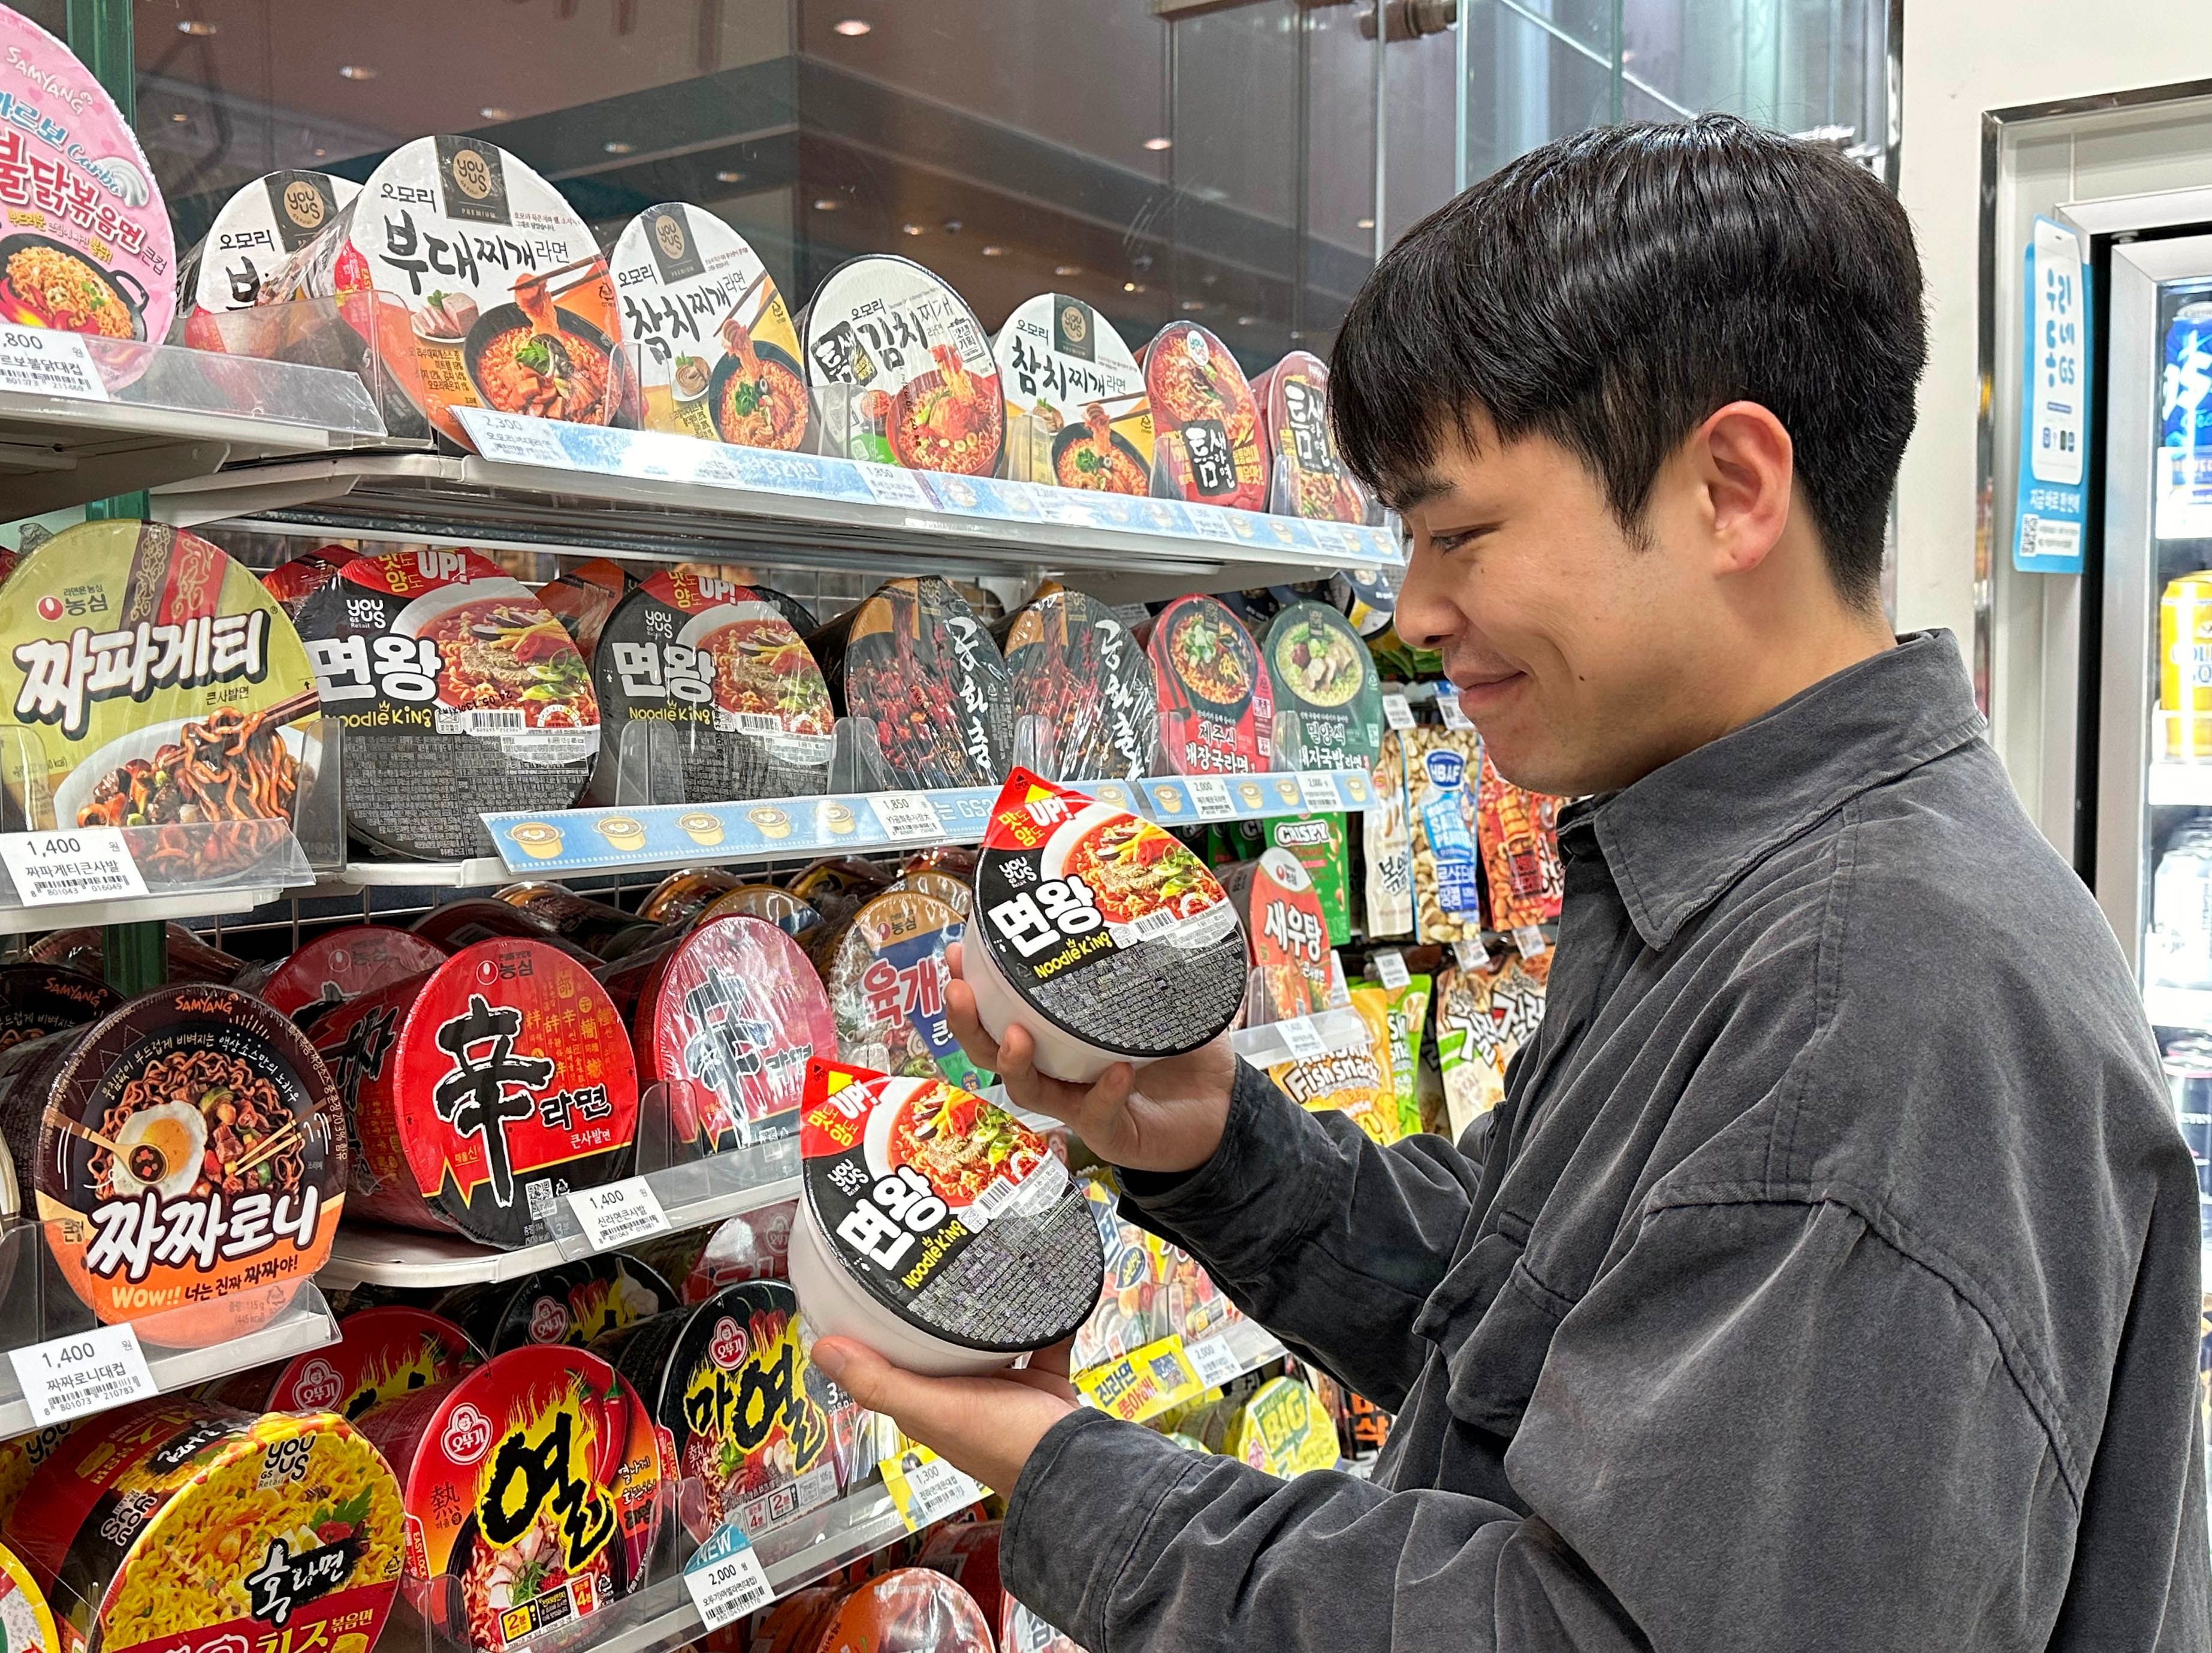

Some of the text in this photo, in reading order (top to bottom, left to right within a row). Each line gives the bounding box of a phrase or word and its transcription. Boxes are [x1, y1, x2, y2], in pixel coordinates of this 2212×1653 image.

[7, 47, 84, 115] SAMYANG
[67, 144, 122, 197] Carbo
[381, 182, 436, 213] 오모리
[461, 208, 496, 219] PREMIUM
[220, 230, 275, 251] 오모리
[141, 246, 168, 276] 큰컵
[618, 263, 659, 288] 오모리
[851, 298, 887, 321] 오모리
[1016, 318, 1049, 346] 오모리
[482, 415, 523, 431] 2,300
[417, 550, 469, 583] UP!
[698, 576, 737, 605] UP!
[65, 594, 108, 617] 농심
[14, 608, 266, 732] 짜파게티
[304, 635, 442, 702] 면왕
[611, 641, 717, 704] 면왕
[206, 686, 249, 705] 큰사발면
[1198, 720, 1237, 751] 제주식
[1306, 721, 1346, 746] 밀양식
[883, 798, 910, 811] 1,850
[955, 797, 999, 819] GS2
[1024, 795, 1075, 826] UP!
[1276, 822, 1329, 843] CRISPY
[27, 838, 120, 858] 1,400 원
[25, 861, 121, 879] 짜파게티큰사발
[31, 883, 123, 898] 8 801043 016049
[988, 876, 1103, 958] 면왕
[1264, 900, 1323, 963] 새우탕
[499, 959, 534, 980] 농심
[43, 977, 100, 1008] SAMYANG
[174, 995, 234, 1015] SAMYANG
[862, 958, 953, 1028] 육개
[134, 1036, 173, 1066] 부드럽게
[176, 1032, 215, 1048] 비벼지는
[276, 1072, 299, 1103] 노하우
[433, 993, 555, 1209] 辛
[539, 1082, 612, 1130] 라면
[829, 1079, 880, 1120] UP!
[570, 1129, 612, 1150] 큰사발면
[589, 1190, 624, 1210] 1,400
[597, 1203, 646, 1227] 신라면큰사발
[835, 1165, 949, 1272] 면왕
[87, 1185, 318, 1280] 짜짜로니
[185, 1253, 299, 1302] 너는 진짜 짜짜야!
[42, 1340, 133, 1369] 1,400 원
[717, 1340, 743, 1359] 오뚜기
[46, 1361, 126, 1392] 짜짜로니대컵
[1094, 1359, 1137, 1408] 진라면
[44, 1386, 134, 1416] 8 801073 210783
[303, 1387, 336, 1404] 오뚜기
[1262, 1388, 1308, 1453] BIG
[451, 1428, 485, 1452] 오뚜기
[258, 1476, 284, 1488] Retail
[260, 1470, 273, 1480] GS
[618, 1456, 651, 1485] 열나게
[915, 1465, 940, 1485] 1,300
[430, 1480, 462, 1520] 熱
[412, 1532, 428, 1579] EASY LOCK
[696, 1528, 733, 1565] NEW
[708, 1564, 737, 1586] 2,000
[330, 1609, 374, 1634] 볶음면
